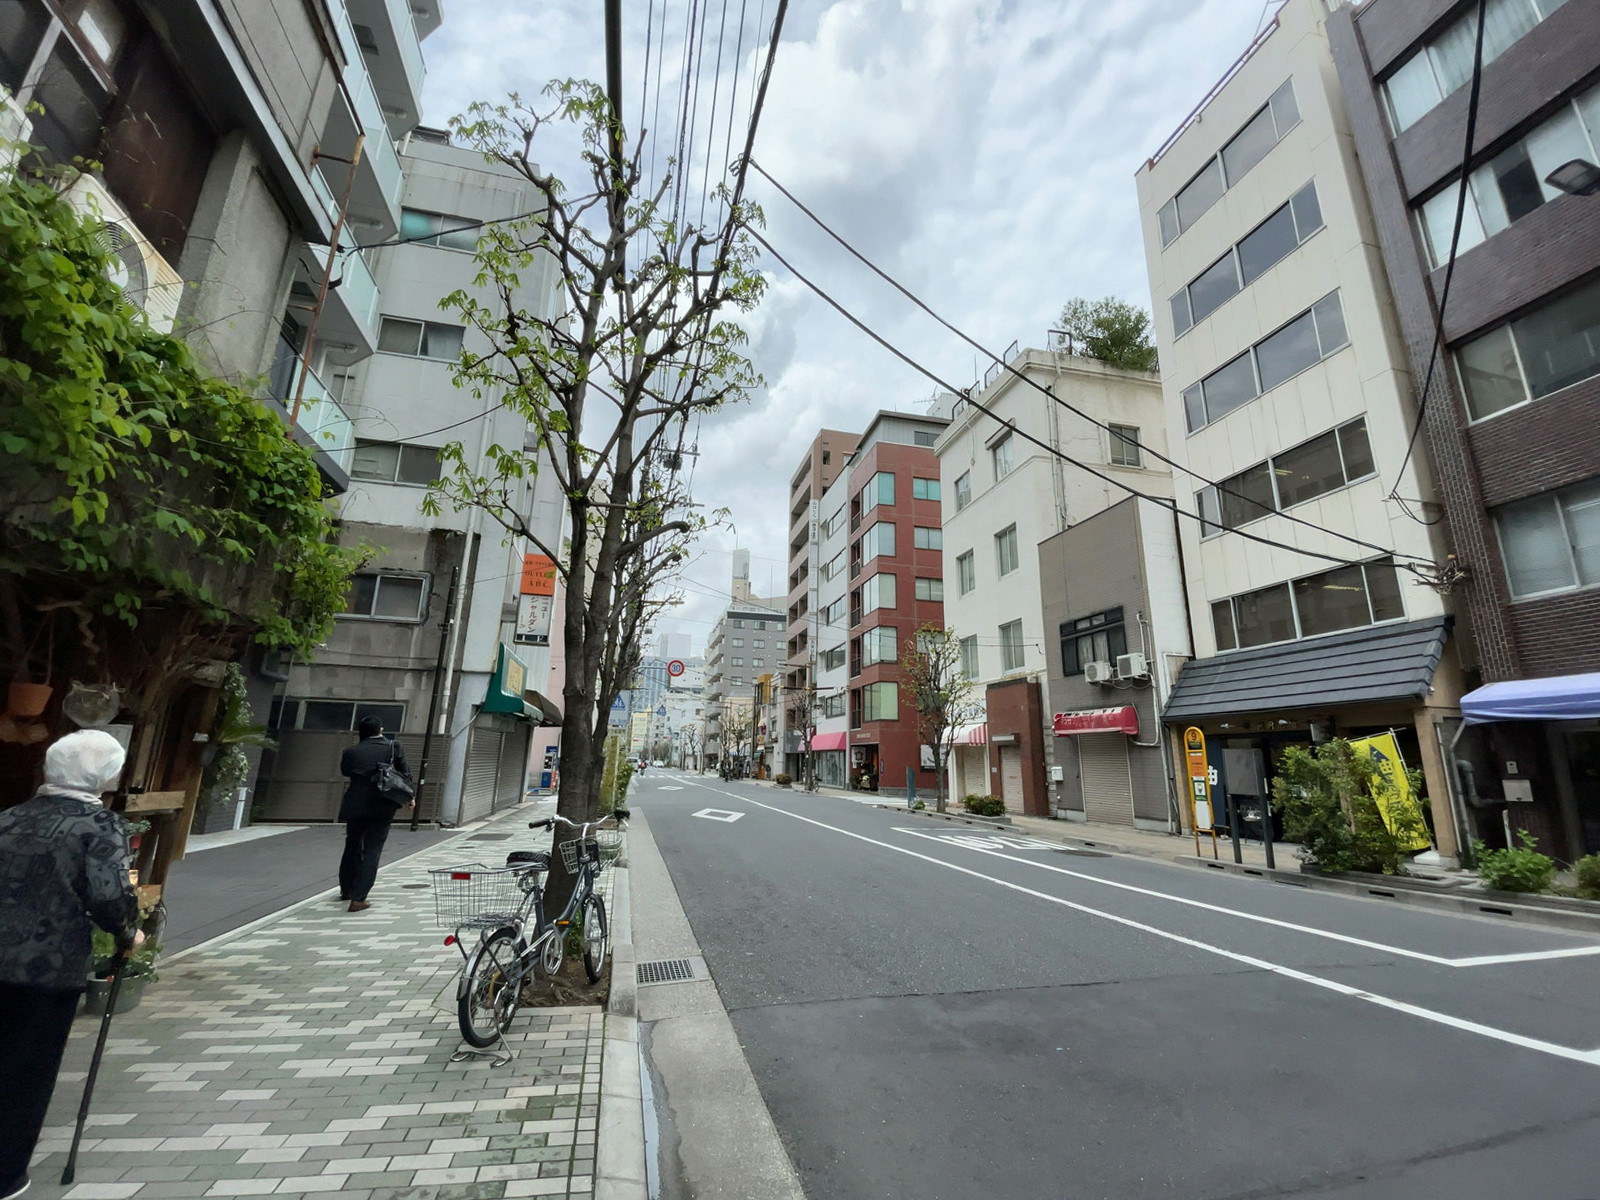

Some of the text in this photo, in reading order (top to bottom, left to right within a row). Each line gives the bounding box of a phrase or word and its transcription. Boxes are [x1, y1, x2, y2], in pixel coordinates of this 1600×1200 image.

[527, 597, 540, 633] ジャルダン
[541, 598, 549, 618] ニュー
[672, 664, 682, 672] 30
[1191, 732, 1197, 741] 9
